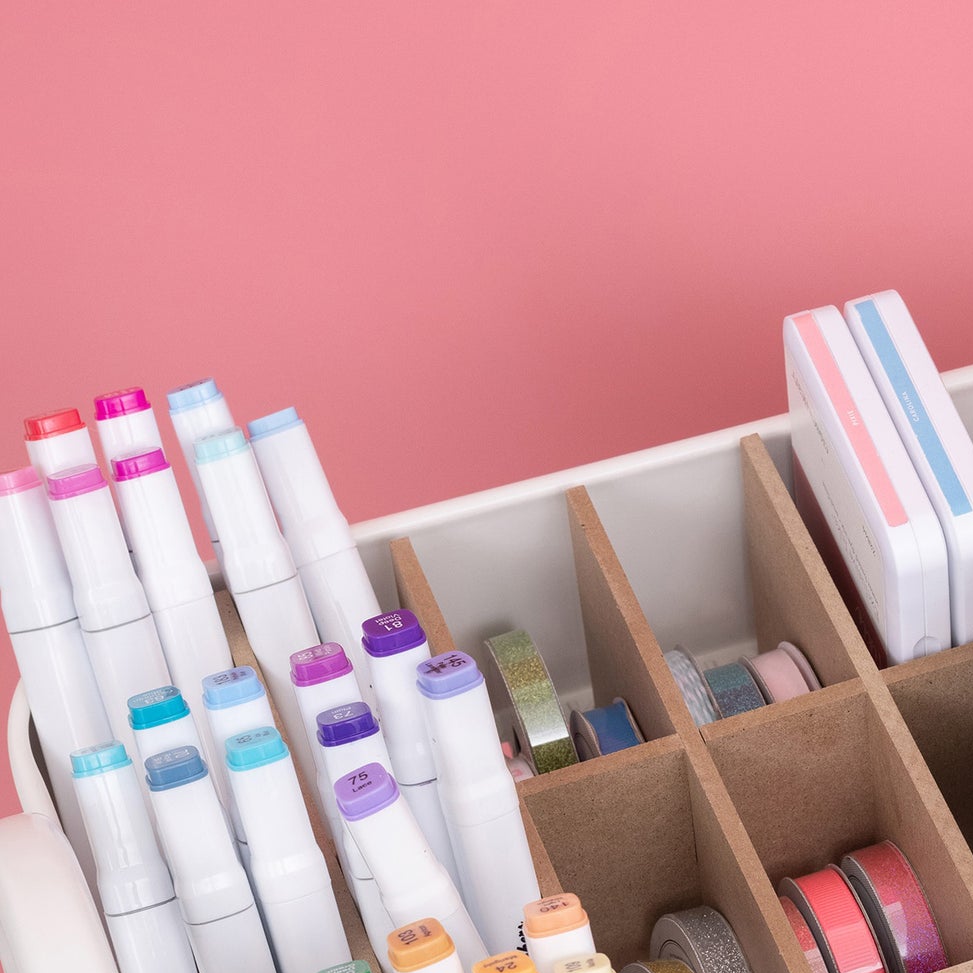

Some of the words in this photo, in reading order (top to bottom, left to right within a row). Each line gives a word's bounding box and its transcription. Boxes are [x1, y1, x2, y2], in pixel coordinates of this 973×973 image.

[902, 391, 920, 423] CAROLINA
[385, 621, 403, 632] 81
[443, 654, 467, 667] 145
[334, 712, 354, 720] 73
[347, 771, 368, 786] 75
[352, 780, 372, 793] Lace
[540, 901, 569, 913] 140
[398, 929, 418, 945] 103
[483, 955, 518, 968] Marigold
[495, 962, 518, 973] 24
